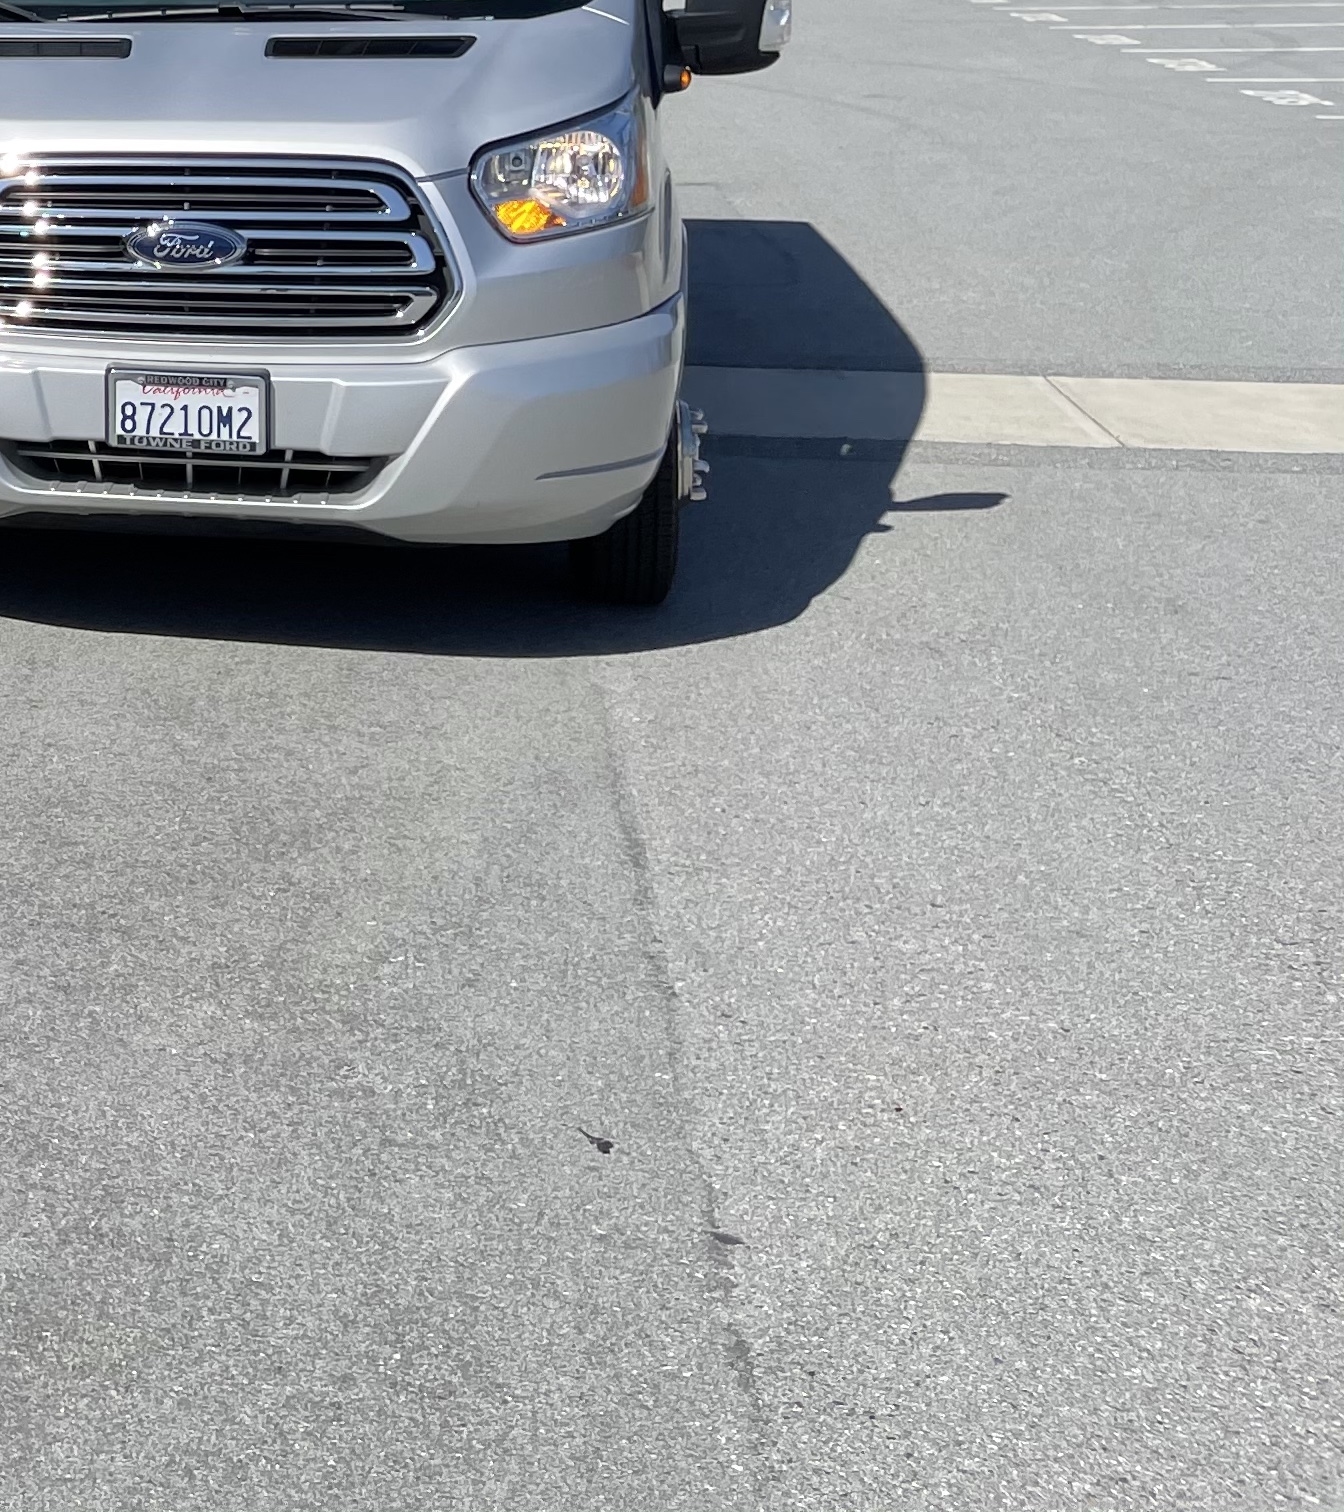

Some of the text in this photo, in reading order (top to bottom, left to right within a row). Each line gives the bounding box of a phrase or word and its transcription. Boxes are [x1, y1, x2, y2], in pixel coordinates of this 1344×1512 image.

[153, 233, 215, 259] Ford
[146, 375, 227, 387] REDWOOD CITY
[120, 400, 253, 441] 87210M2
[124, 436, 251, 452] TOWNE FORD
